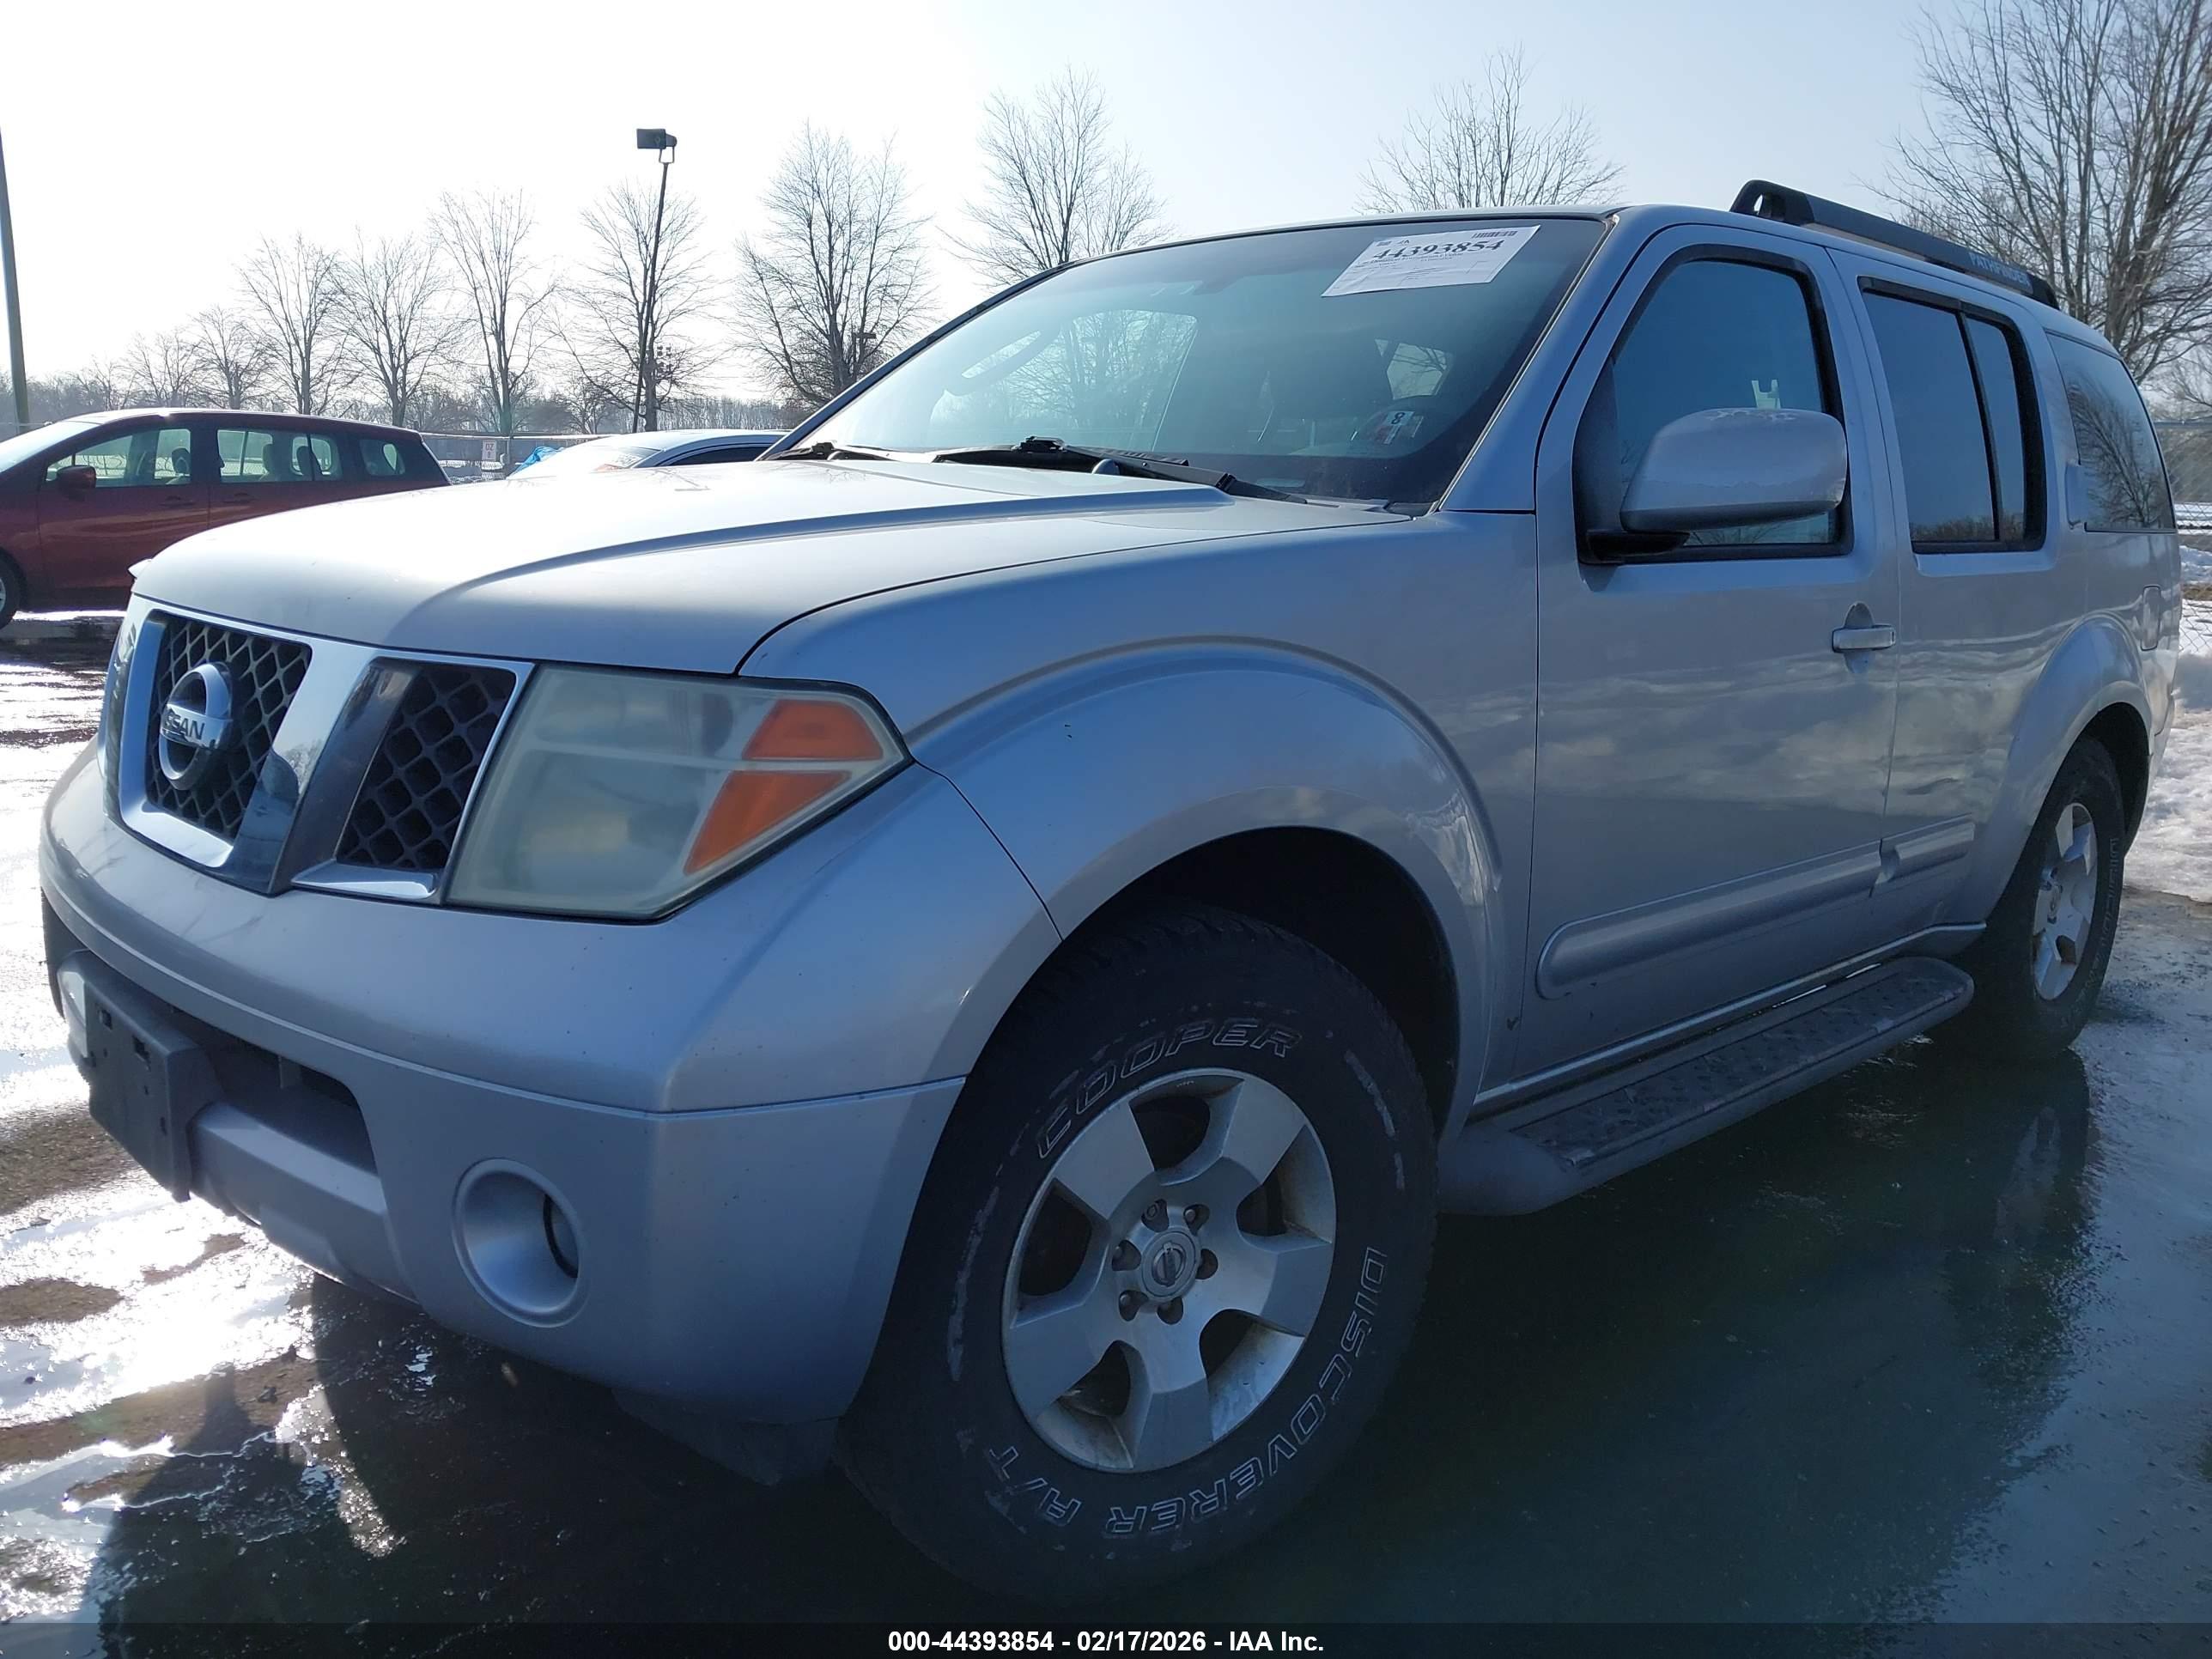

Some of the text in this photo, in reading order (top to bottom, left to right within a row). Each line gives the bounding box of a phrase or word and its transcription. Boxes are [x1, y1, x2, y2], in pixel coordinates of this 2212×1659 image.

[1373, 239, 1504, 259] 44393854
[1391, 412, 1406, 425] 8
[1036, 1018, 1303, 1158] COOPER
[988, 1247, 1388, 1535] DISCOVERER A/T
